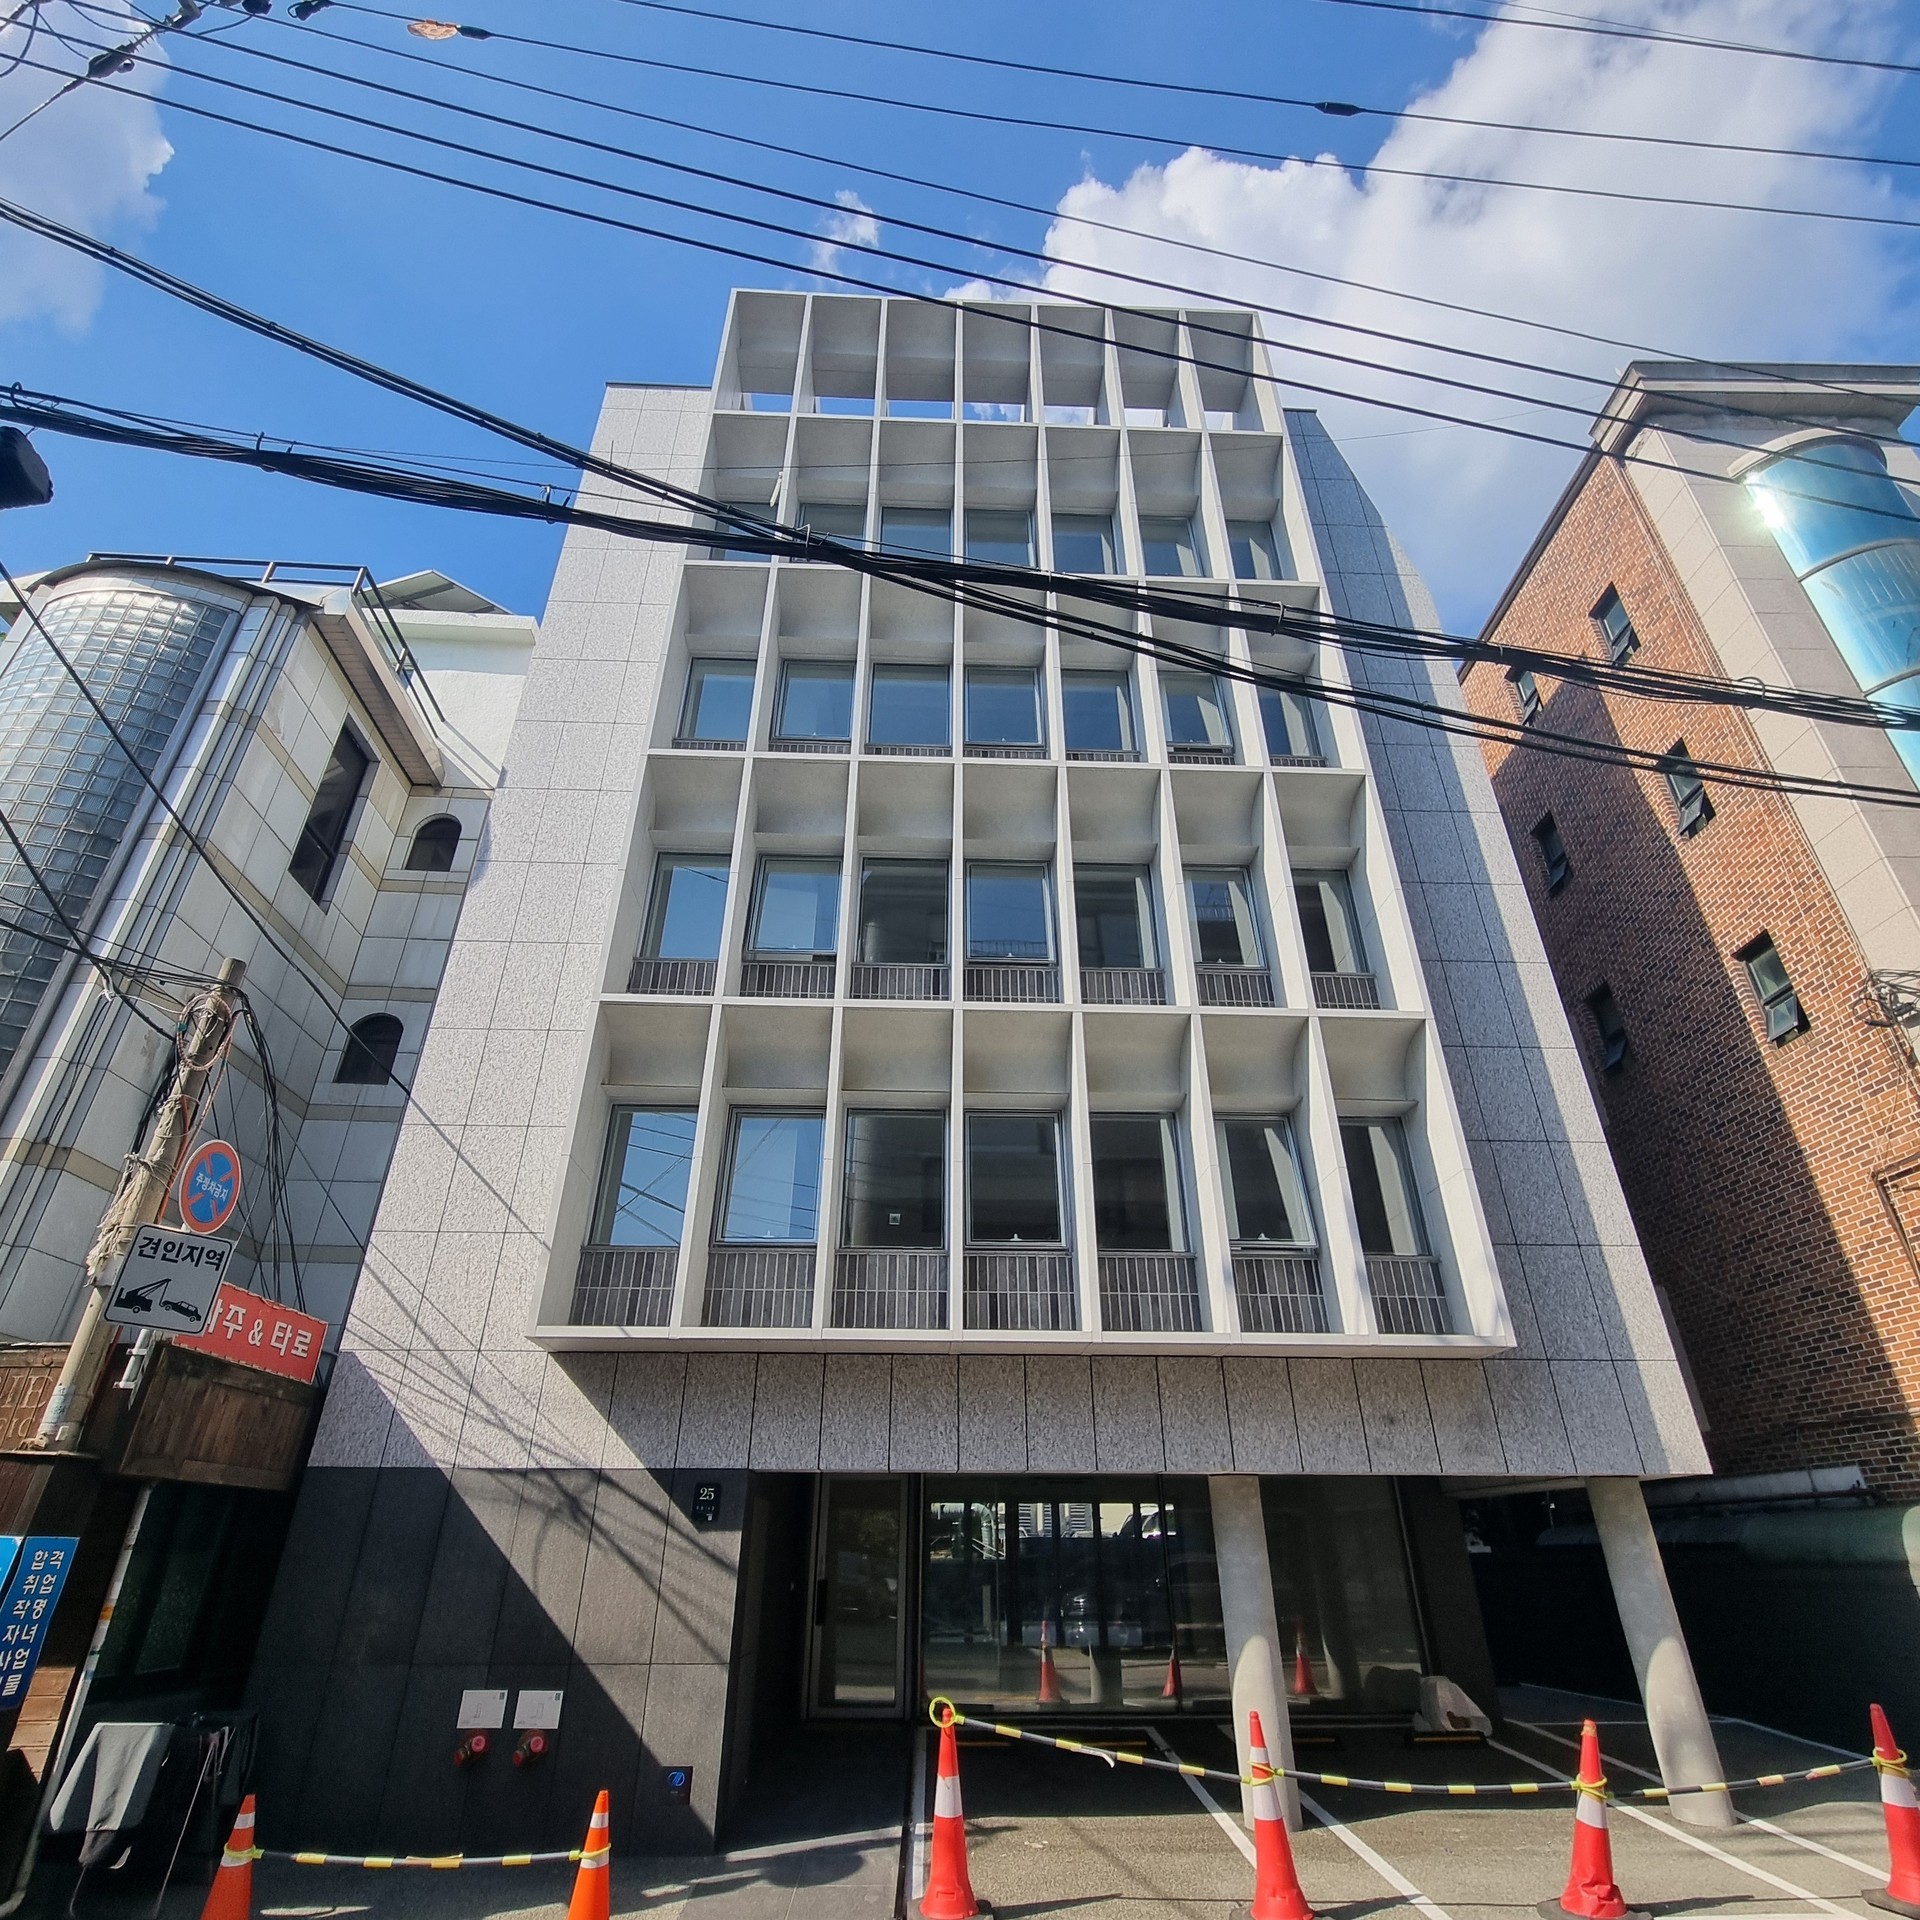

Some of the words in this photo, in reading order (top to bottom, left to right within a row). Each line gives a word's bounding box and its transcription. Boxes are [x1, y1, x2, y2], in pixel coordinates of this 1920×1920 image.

[196, 1172, 229, 1202] 주정차금지
[138, 1237, 225, 1272] 견인지역
[248, 1319, 263, 1346] &
[270, 1321, 312, 1358] 타로
[699, 1487, 715, 1500] 25
[31, 1550, 64, 1570] 합격
[22, 1574, 57, 1594] 취업
[12, 1599, 48, 1620] 작명
[2, 1623, 38, 1645] 자녀
[0, 1674, 22, 1696] 물
